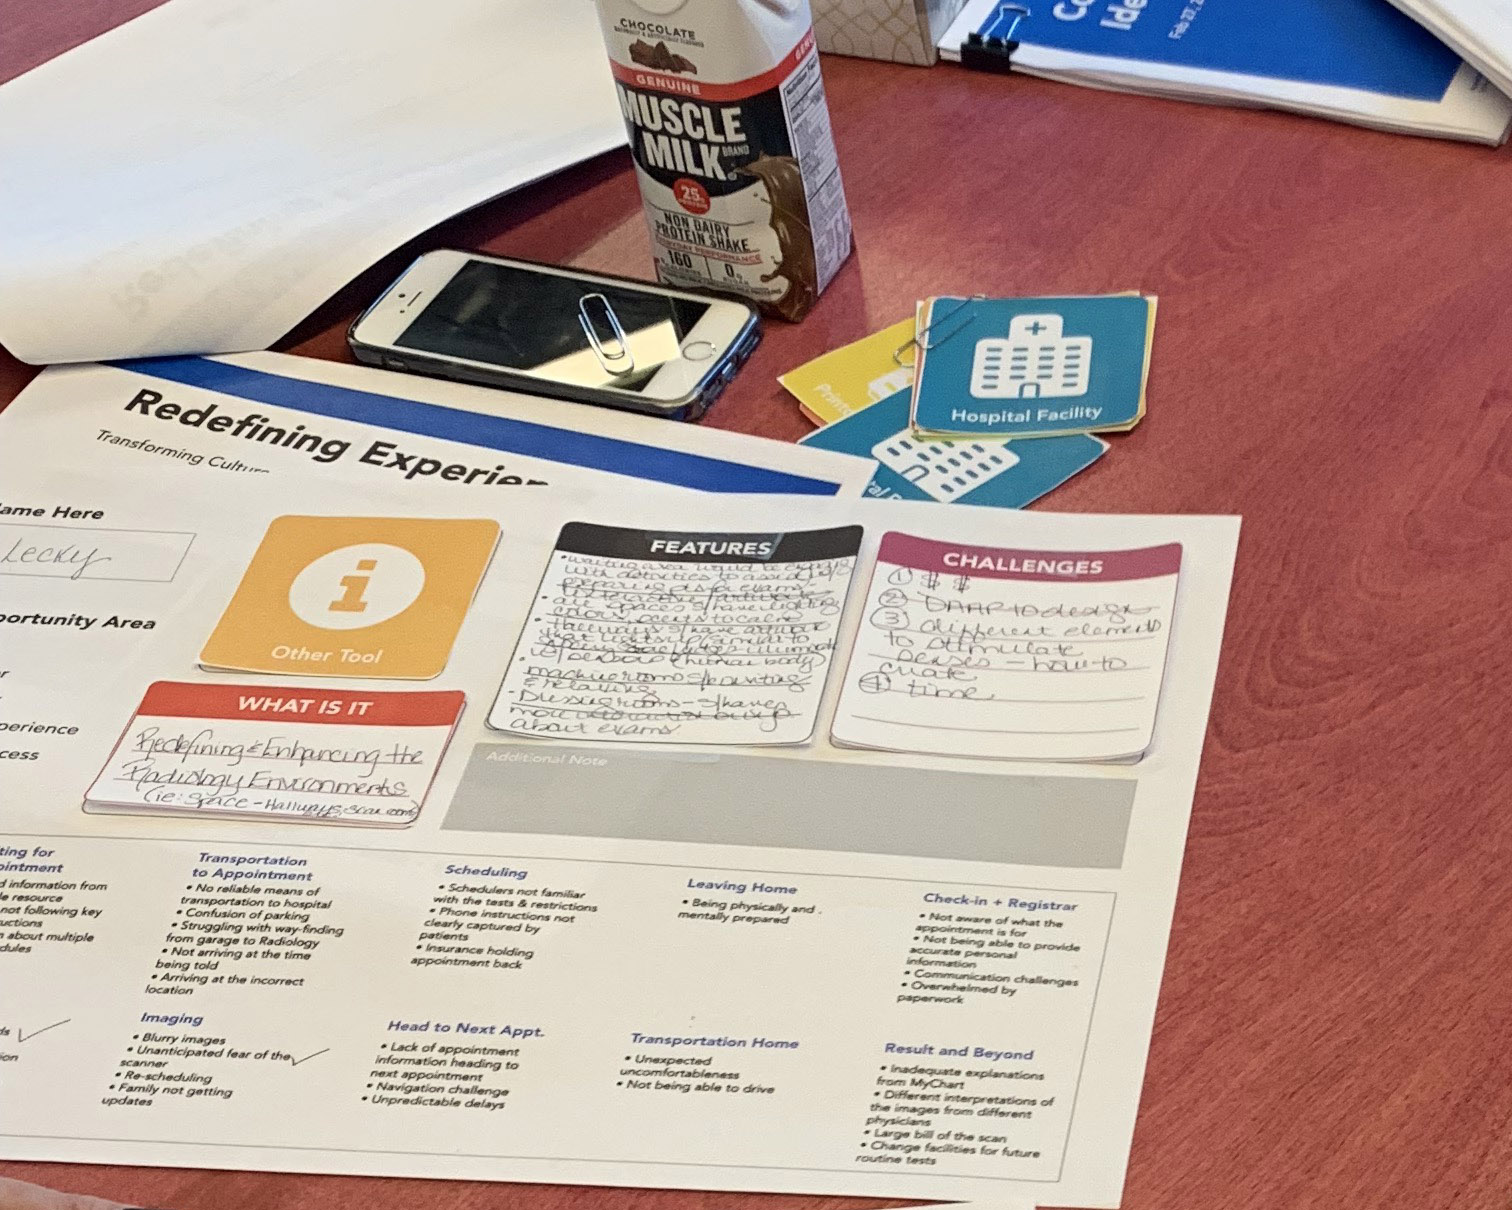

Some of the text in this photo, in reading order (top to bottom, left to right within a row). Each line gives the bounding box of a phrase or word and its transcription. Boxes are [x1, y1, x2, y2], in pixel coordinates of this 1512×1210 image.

[619, 17, 696, 41] CHOCOLATE
[636, 74, 701, 96] GENUINE
[618, 89, 747, 143] MUSCLE
[643, 134, 727, 182] MILK
[664, 212, 730, 235] NON DAIRY
[655, 220, 706, 246] PROTEIN
[709, 233, 750, 251] SHAKE
[668, 250, 692, 269] 160
[951, 405, 1103, 426] Hospital Facility
[124, 388, 352, 463] Redefining
[96, 429, 205, 466] Transforming
[0, 504, 105, 520] ame Here
[650, 539, 772, 556] FEATURES
[942, 552, 1104, 575] CHALLENGES
[101, 615, 156, 630] Area
[271, 645, 383, 663] Other Tool
[239, 696, 374, 715] WHAT IS IT
[485, 751, 608, 766] Additional Note
[199, 852, 307, 866] Transportation
[192, 868, 313, 882] to Appointment
[444, 864, 528, 880] Scheduling
[195, 883, 321, 896] No reliable means of
[687, 878, 798, 894] Leaving Home
[181, 895, 334, 911] transportation to hospital
[692, 898, 816, 914] Being physically and
[923, 893, 988, 906] Check-in
[1008, 898, 1079, 911] Registrar
[140, 1012, 204, 1027] Imaging
[387, 1020, 545, 1039] Head to Next Appt.
[142, 1033, 226, 1047] Blurry images
[631, 1033, 799, 1049] Transportation Home
[885, 1043, 1035, 1062] Result and Beyond
